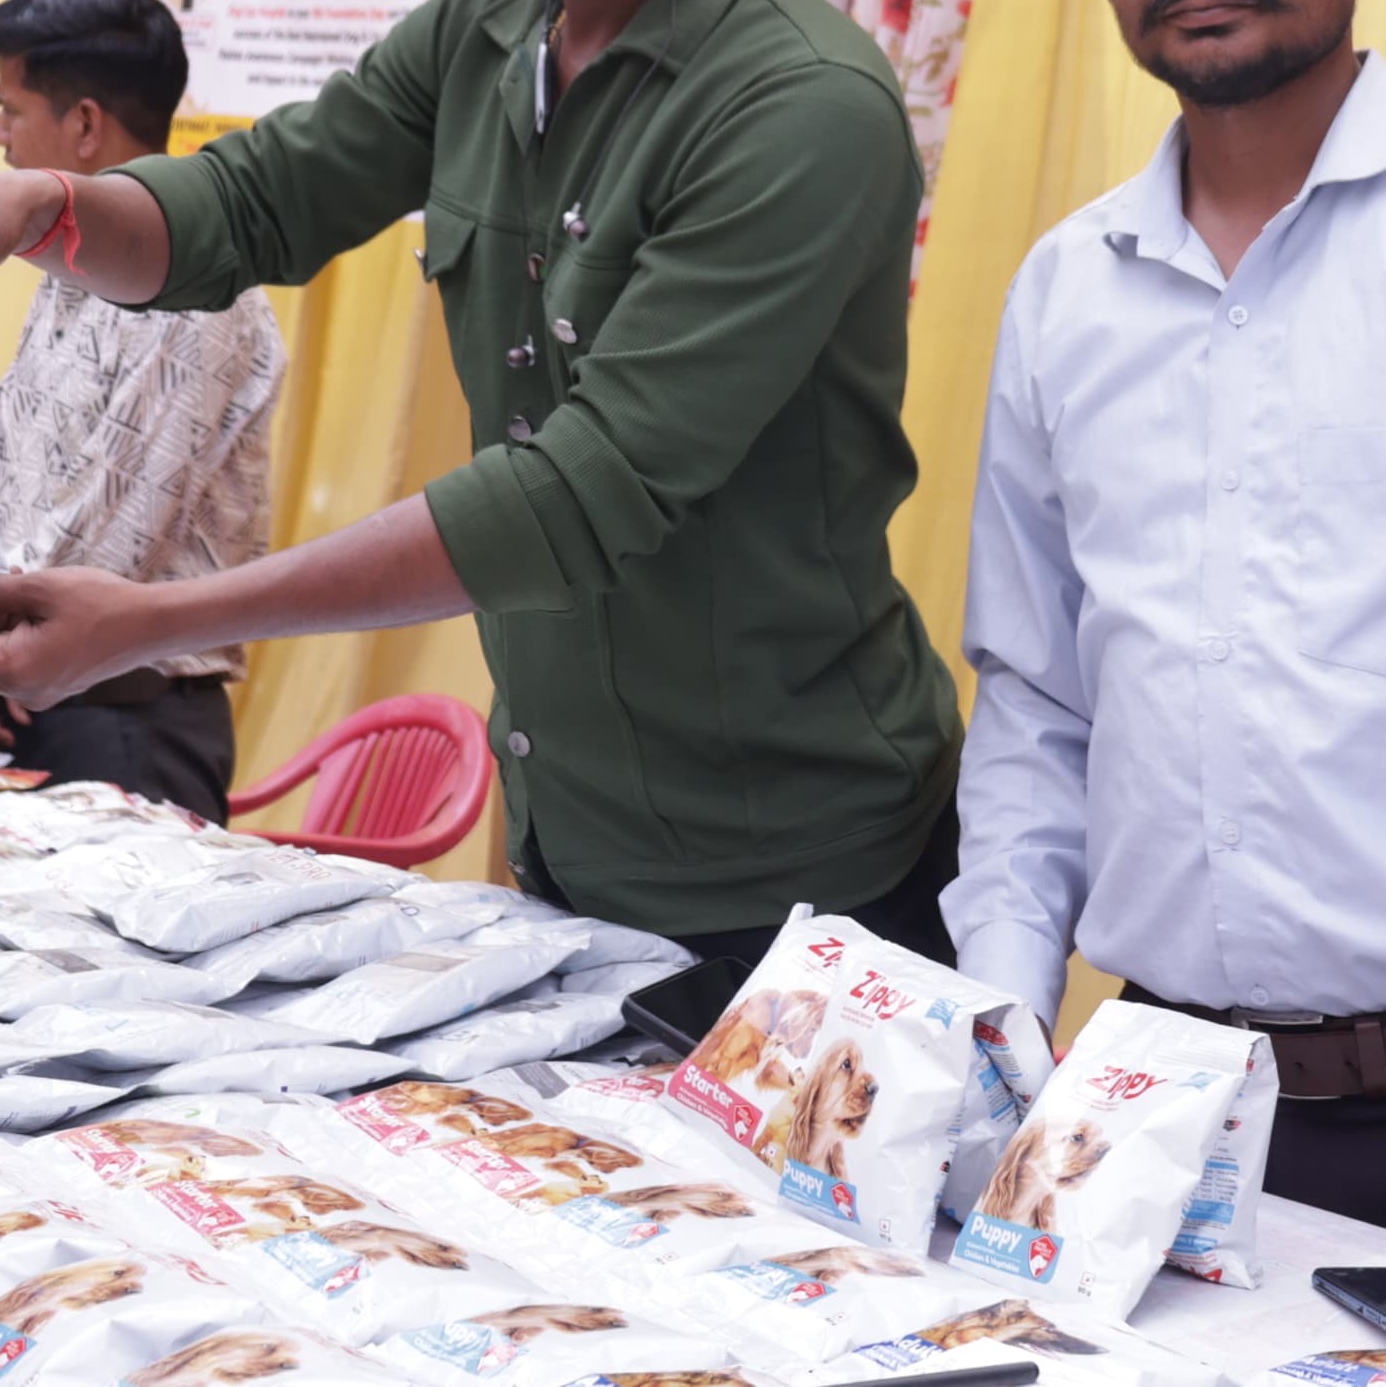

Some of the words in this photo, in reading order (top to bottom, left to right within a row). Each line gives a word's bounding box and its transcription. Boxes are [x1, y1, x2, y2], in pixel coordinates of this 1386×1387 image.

[849, 970, 916, 1020] Zippy
[683, 1065, 735, 1108] Starter
[1085, 1065, 1168, 1100] Zippy
[784, 1158, 824, 1198] Puppy
[971, 1216, 1022, 1253] Puppy
